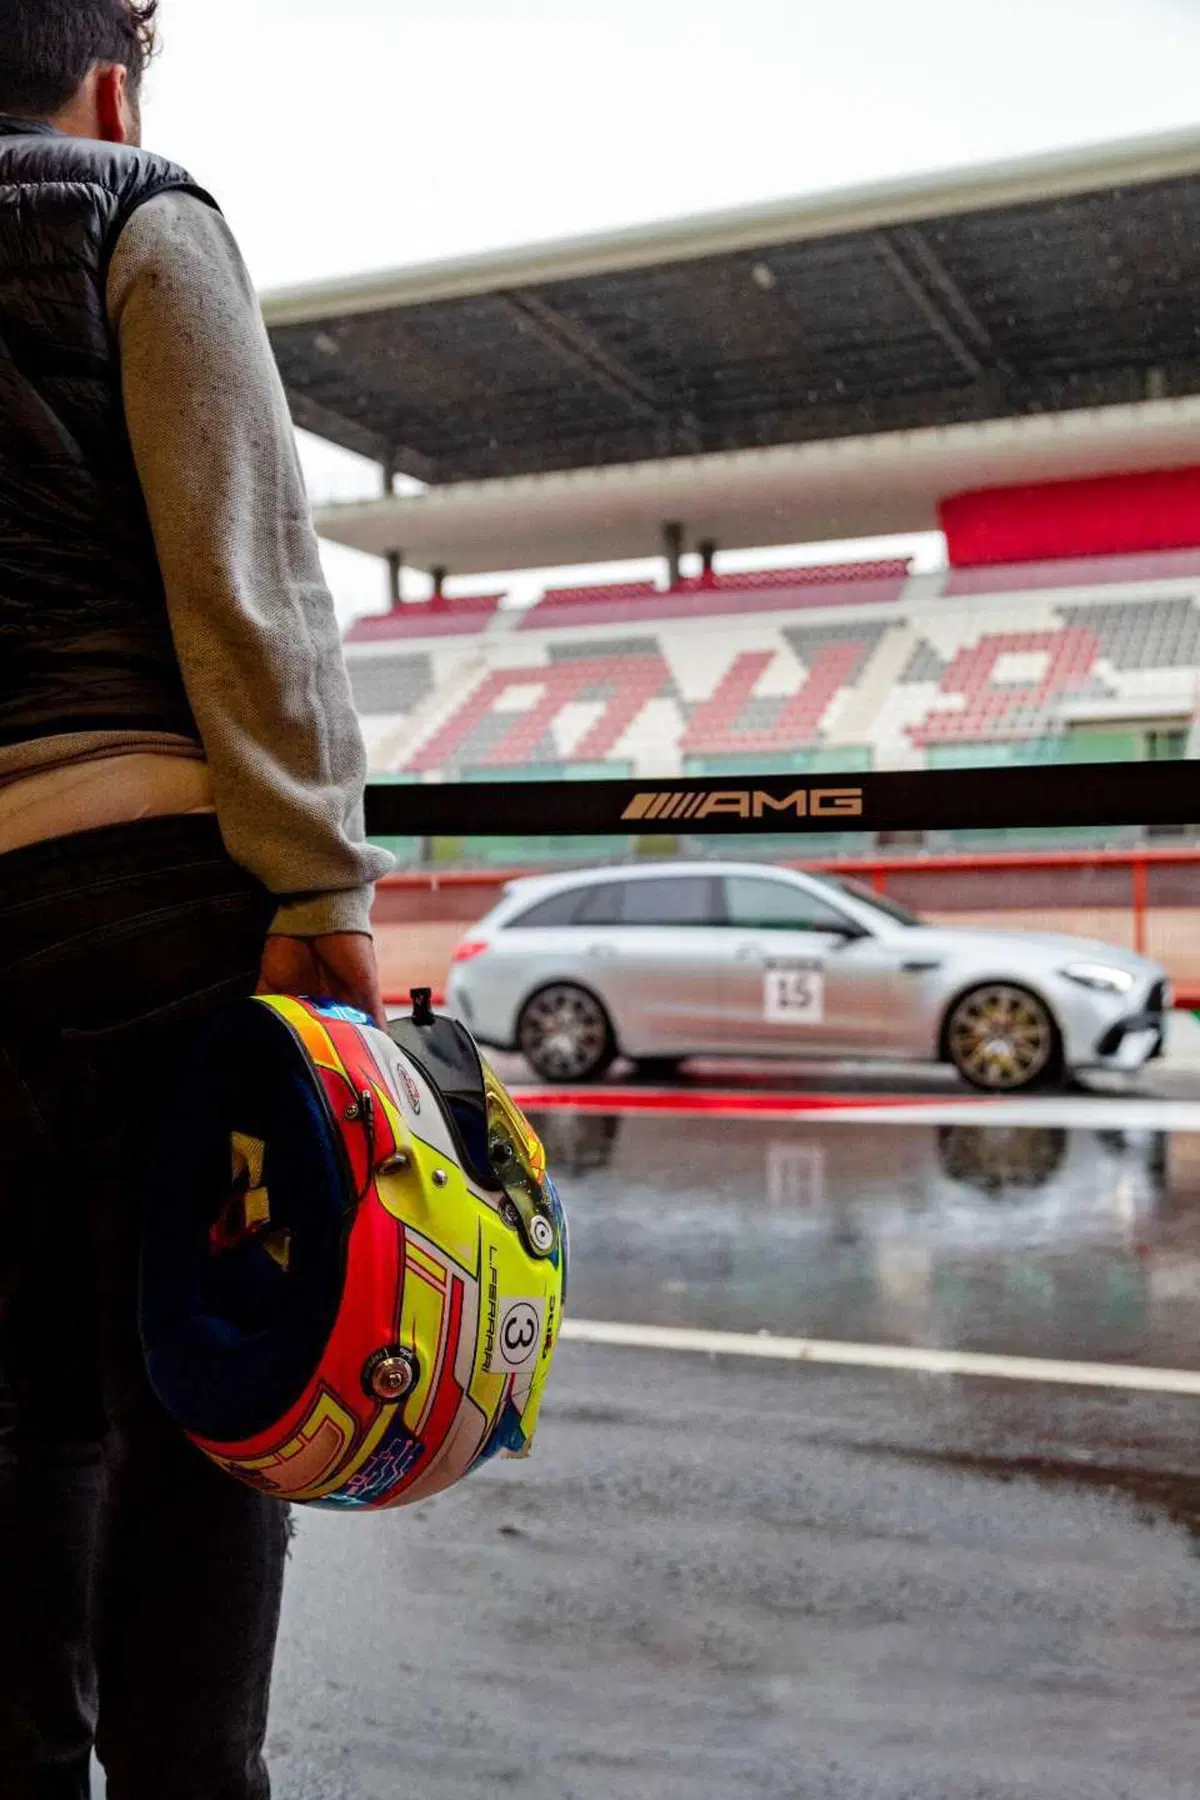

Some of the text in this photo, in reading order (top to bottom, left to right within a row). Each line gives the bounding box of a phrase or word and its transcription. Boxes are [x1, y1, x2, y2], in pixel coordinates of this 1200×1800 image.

[693, 788, 862, 819] AMG
[777, 975, 814, 1009] 15
[481, 1245, 498, 1373] L.FERRARI
[505, 1316, 535, 1349] 3
